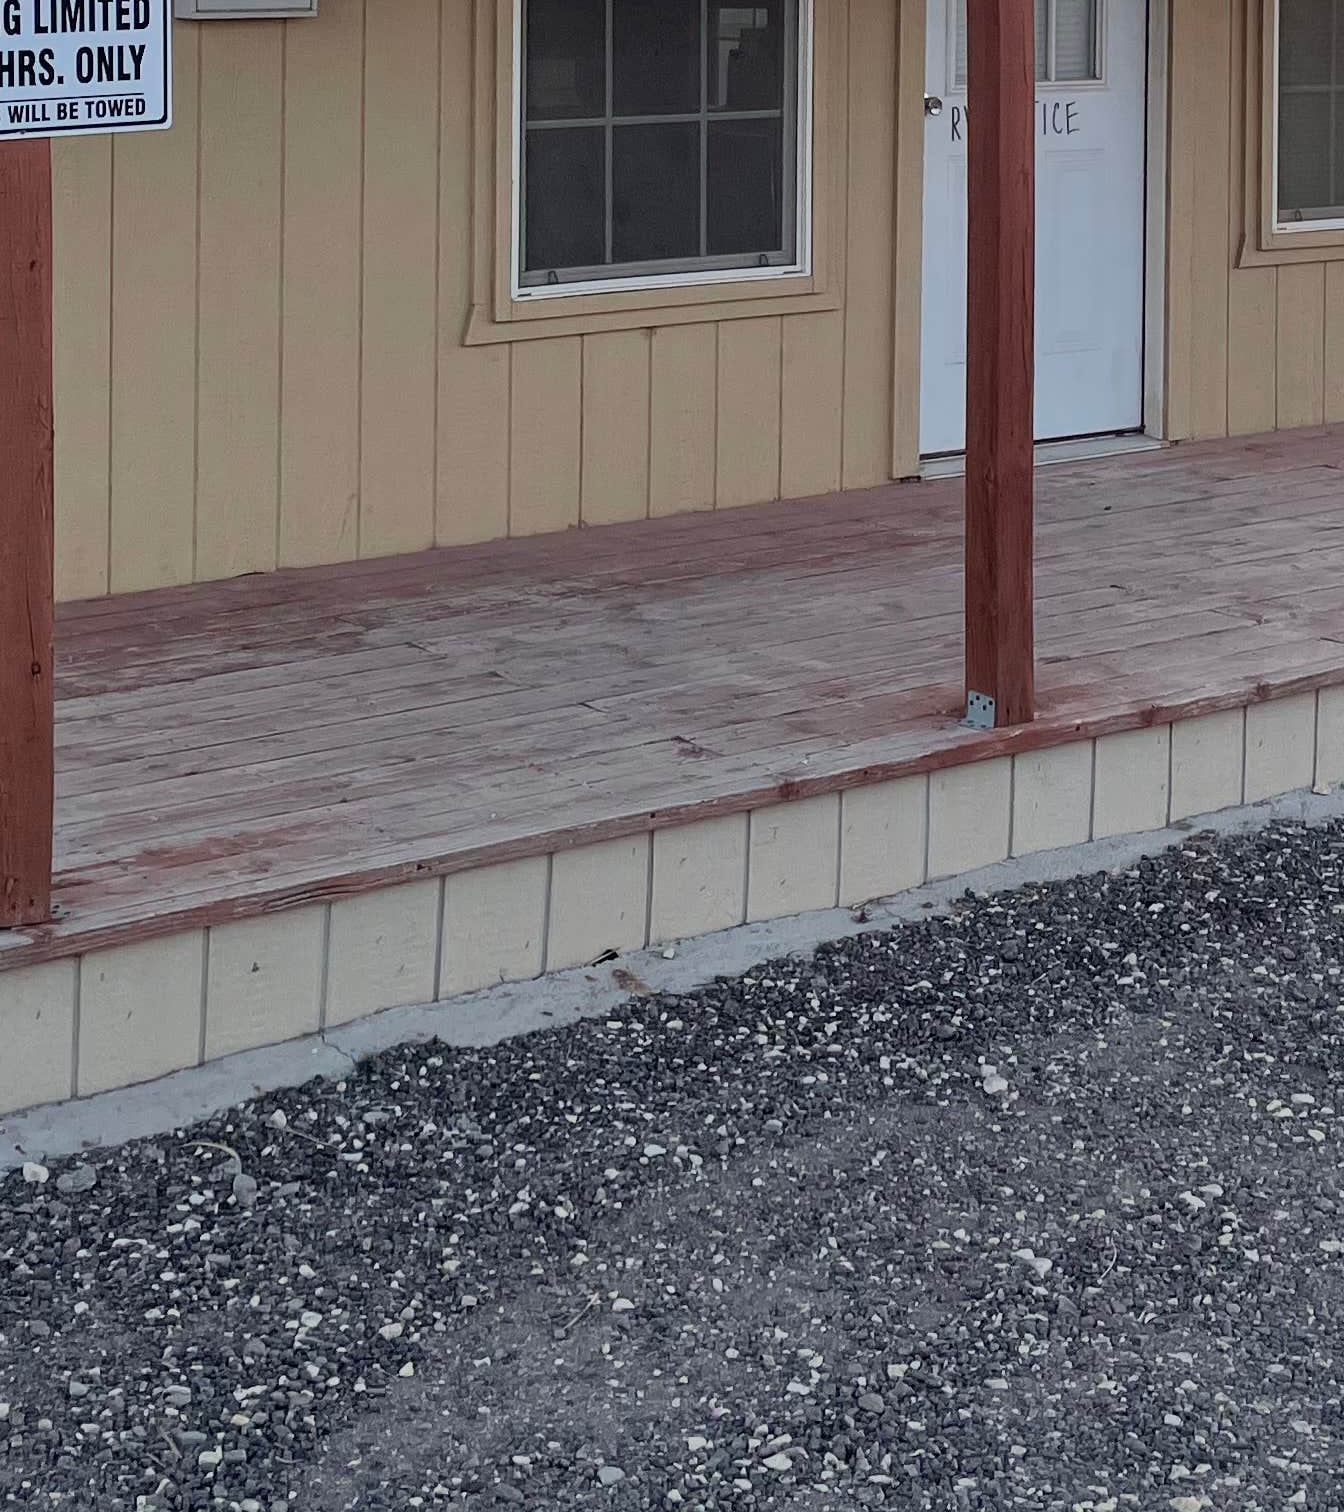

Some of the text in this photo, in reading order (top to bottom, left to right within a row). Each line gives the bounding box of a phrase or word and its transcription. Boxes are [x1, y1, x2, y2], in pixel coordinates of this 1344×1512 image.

[76, 44, 147, 84] ONLY
[7, 103, 51, 124] WILL
[56, 101, 79, 121] BE
[84, 98, 147, 120] TOWED
[1035, 100, 1081, 136] ICE
